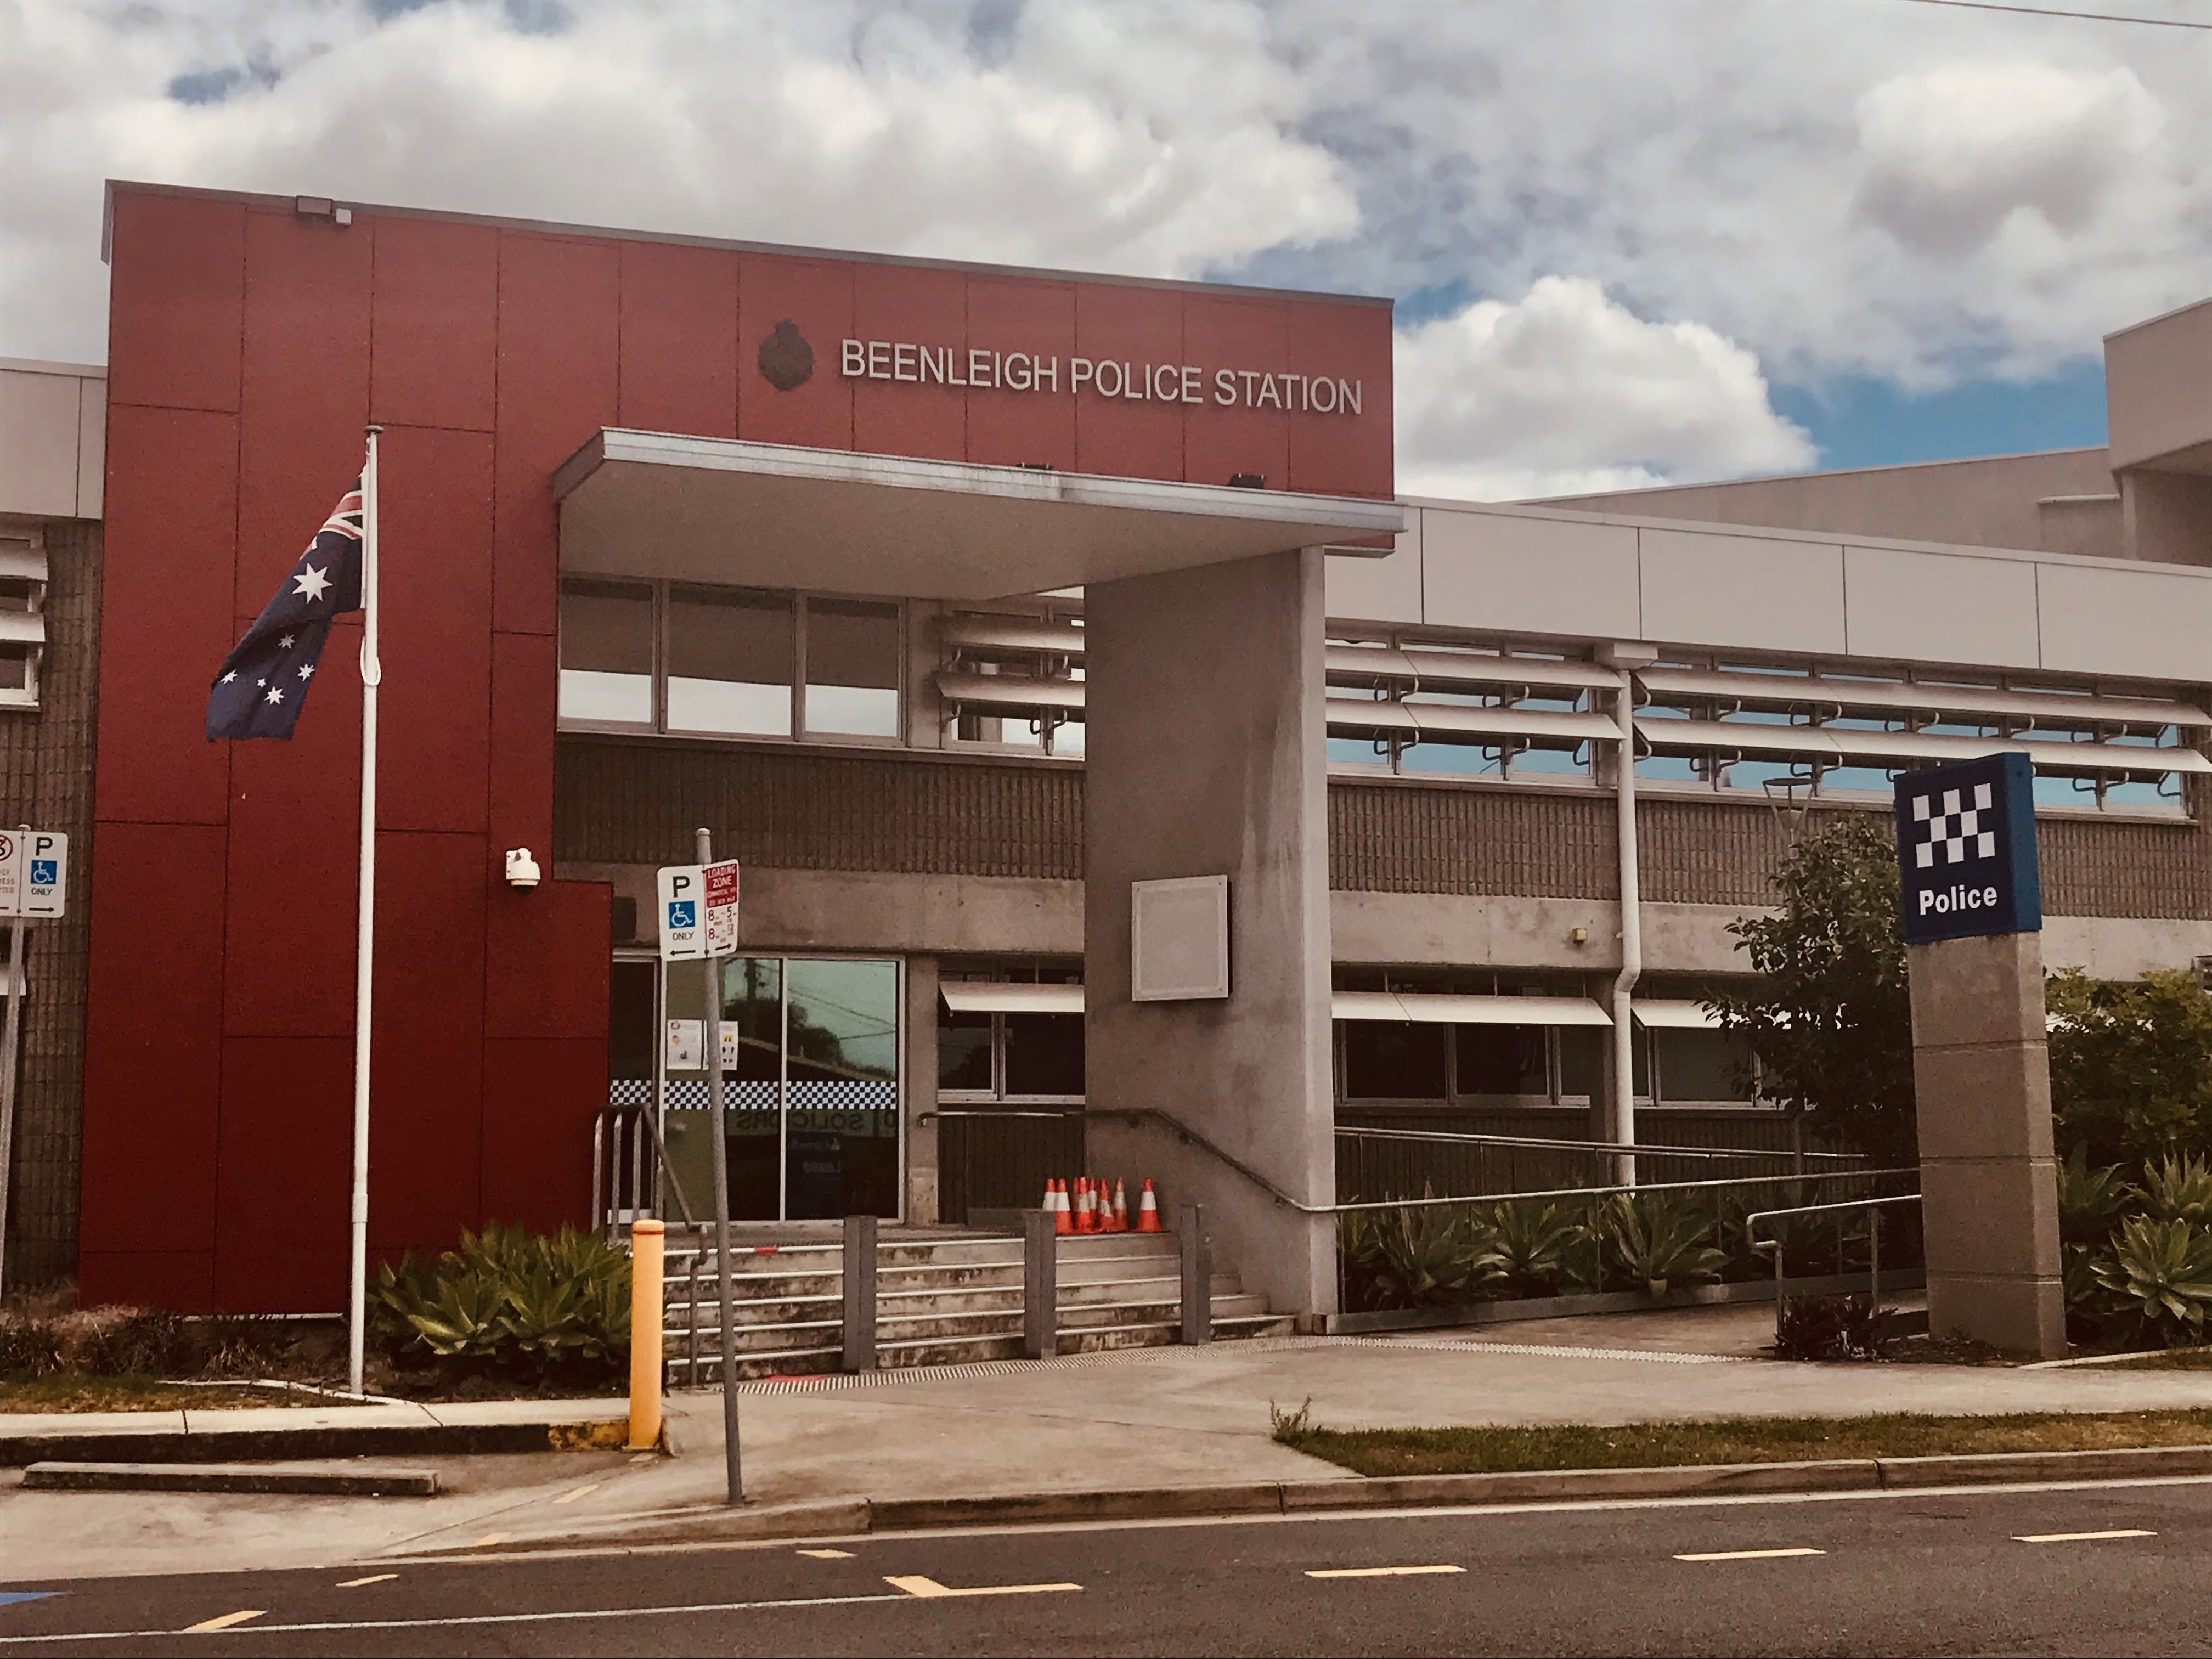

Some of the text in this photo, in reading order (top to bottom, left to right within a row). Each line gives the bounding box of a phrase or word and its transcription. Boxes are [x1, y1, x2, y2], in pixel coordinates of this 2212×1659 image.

[842, 338, 1361, 415] BEENLEIGH POLICE STATION
[36, 837, 53, 856] P
[708, 865, 736, 878] LOADING
[673, 876, 690, 898] P
[713, 876, 732, 889] ZONE
[31, 887, 53, 896] ONLY
[1919, 884, 1997, 915] Police
[673, 932, 695, 941] ONLY
